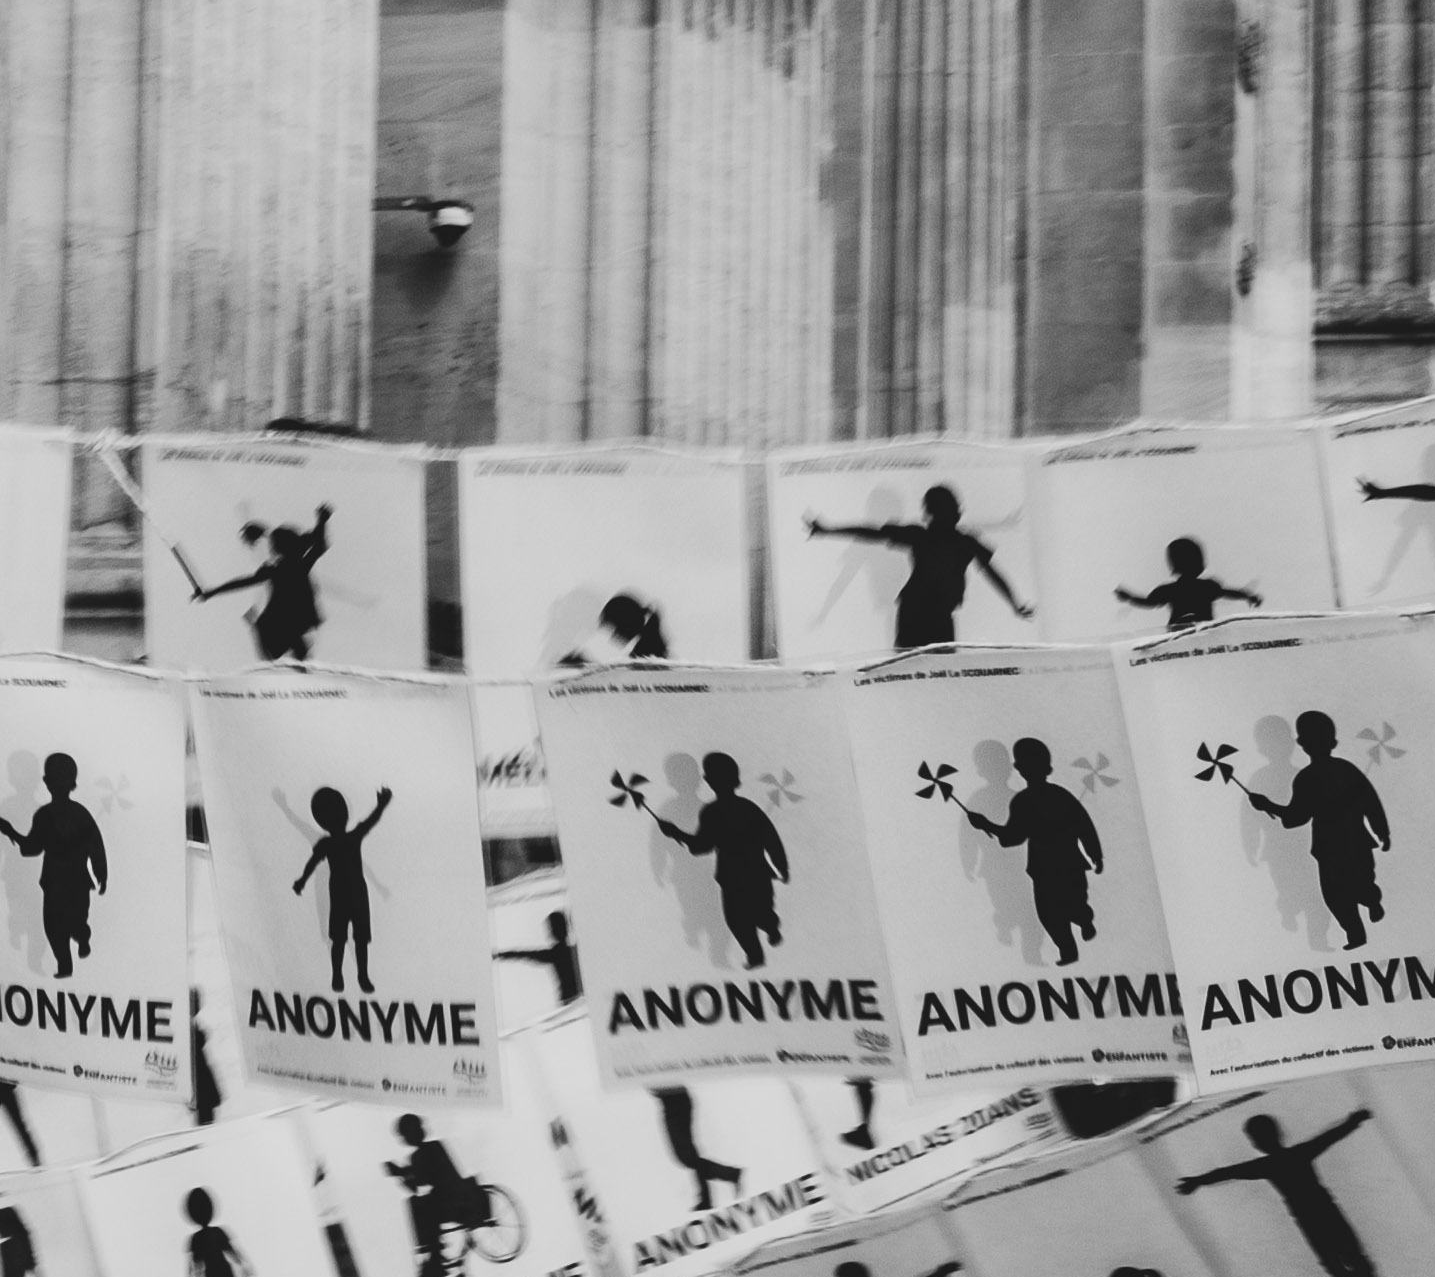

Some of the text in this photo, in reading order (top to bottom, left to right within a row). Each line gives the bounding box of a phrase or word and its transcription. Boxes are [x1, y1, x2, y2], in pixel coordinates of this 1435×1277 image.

[914, 670, 926, 680] de
[928, 668, 947, 679] Joël
[1149, 650, 1189, 664] victimes
[1192, 647, 1203, 657] de
[1206, 644, 1225, 655] Joël
[1227, 643, 1239, 653] Le
[1241, 637, 1302, 651] SCOUARNEC
[248, 988, 481, 1047] ANONYME
[608, 979, 884, 1036] ANONYME
[1105, 1051, 1168, 1062] ENFANTISTE
[845, 1125, 954, 1185] NICOLAS
[632, 1172, 827, 1273] ANONYME
